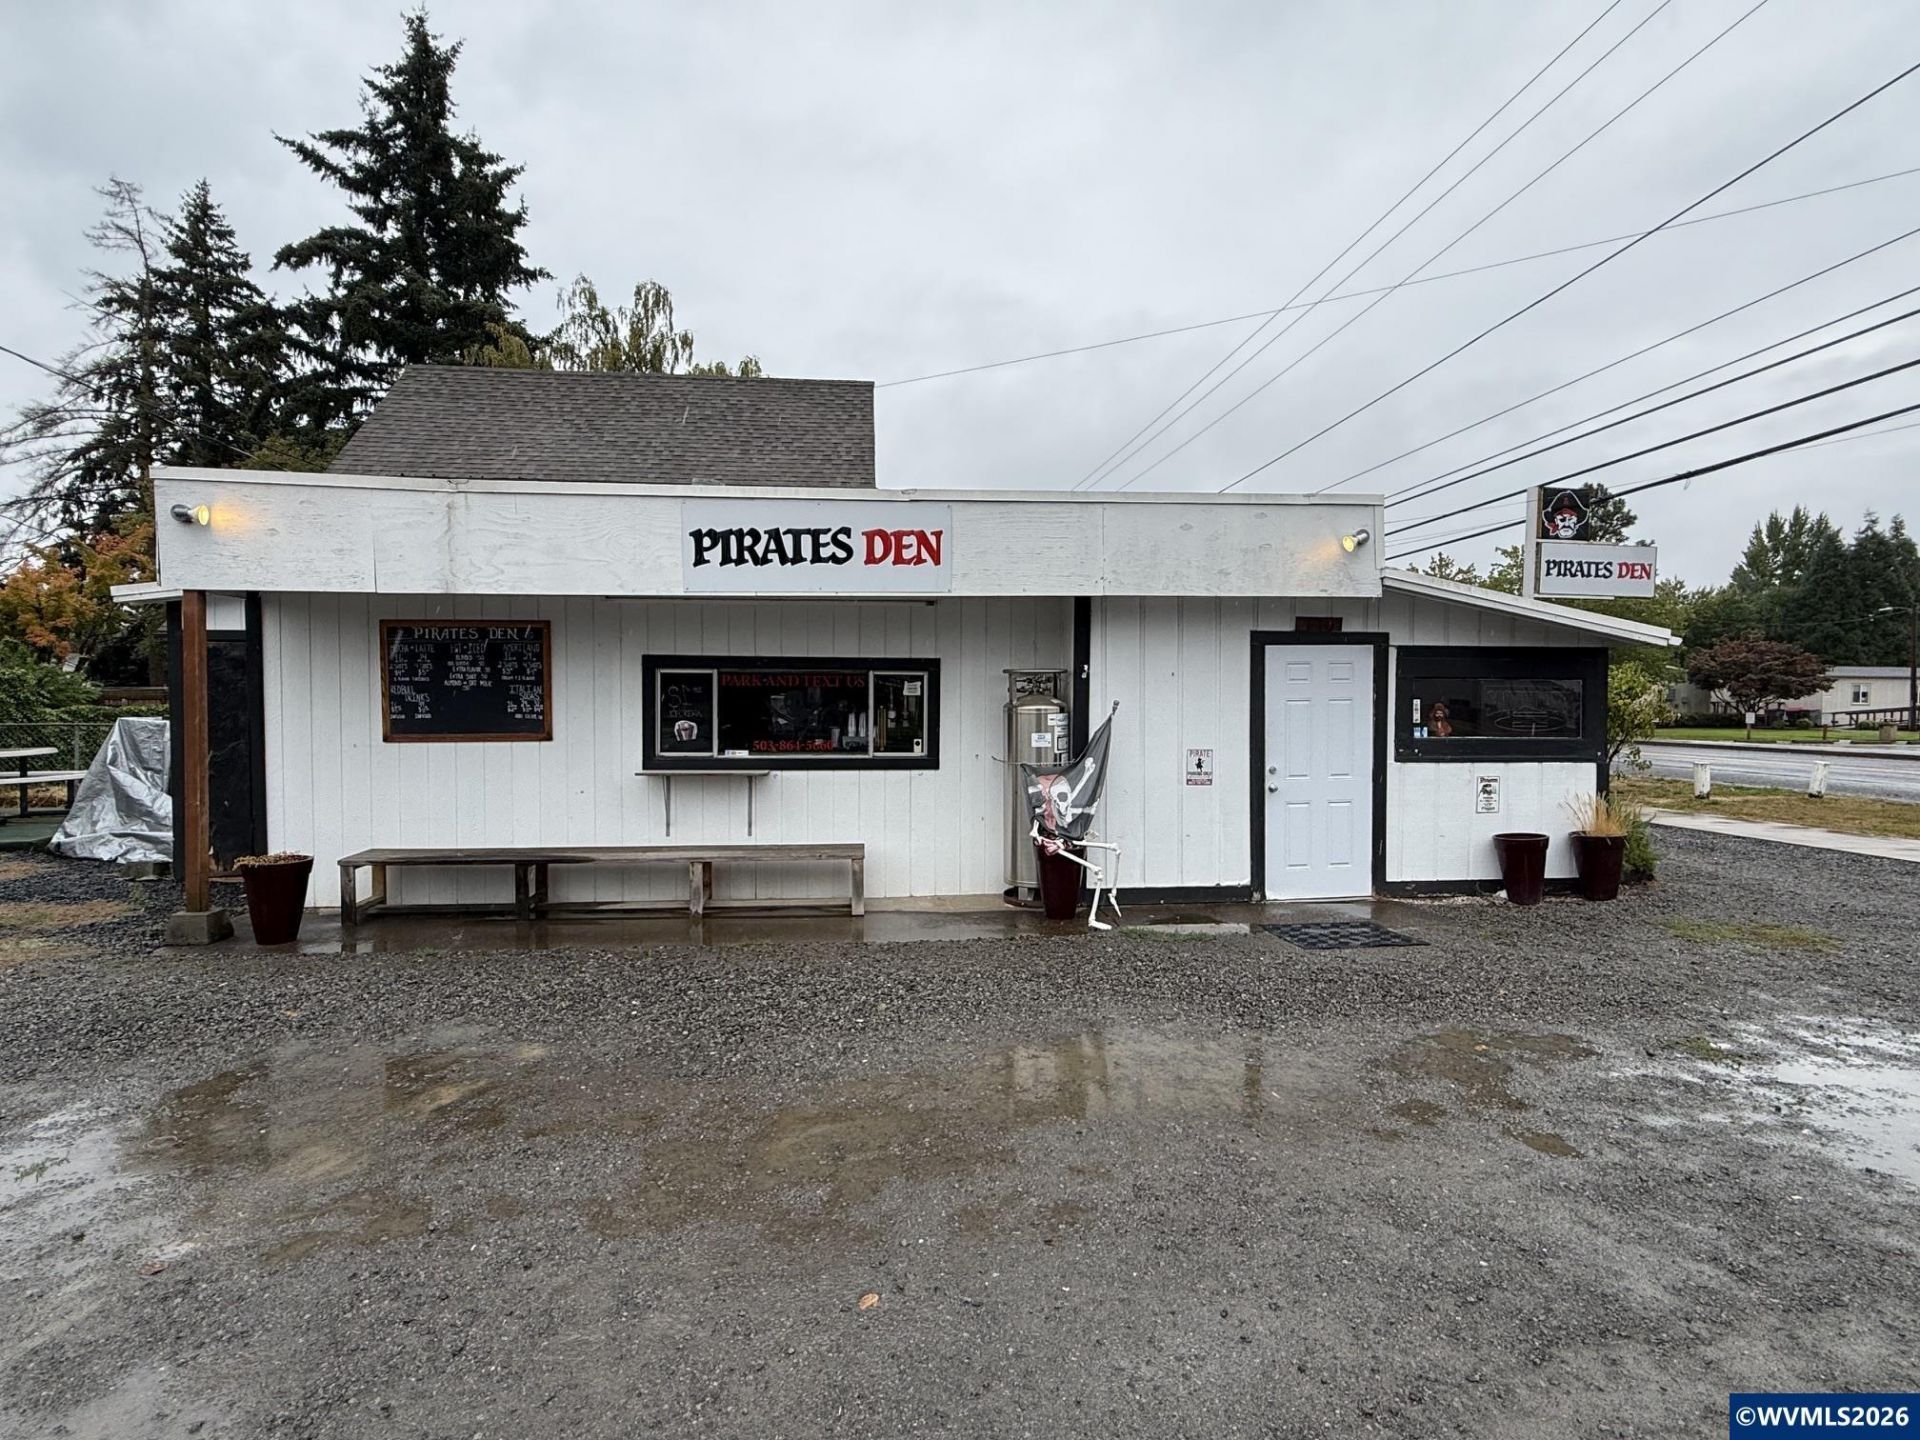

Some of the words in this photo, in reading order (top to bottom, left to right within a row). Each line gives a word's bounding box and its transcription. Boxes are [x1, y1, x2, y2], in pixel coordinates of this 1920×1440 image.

[689, 526, 854, 567] PIRATES
[861, 528, 944, 567] DEN
[1545, 559, 1613, 579] PIRATES
[1617, 561, 1653, 580] DEN
[412, 627, 479, 641] PIRATES
[488, 626, 519, 640] DEN
[721, 674, 762, 687] PARK
[766, 674, 800, 687] AND
[803, 674, 842, 688] TEXT
[846, 674, 866, 688] US
